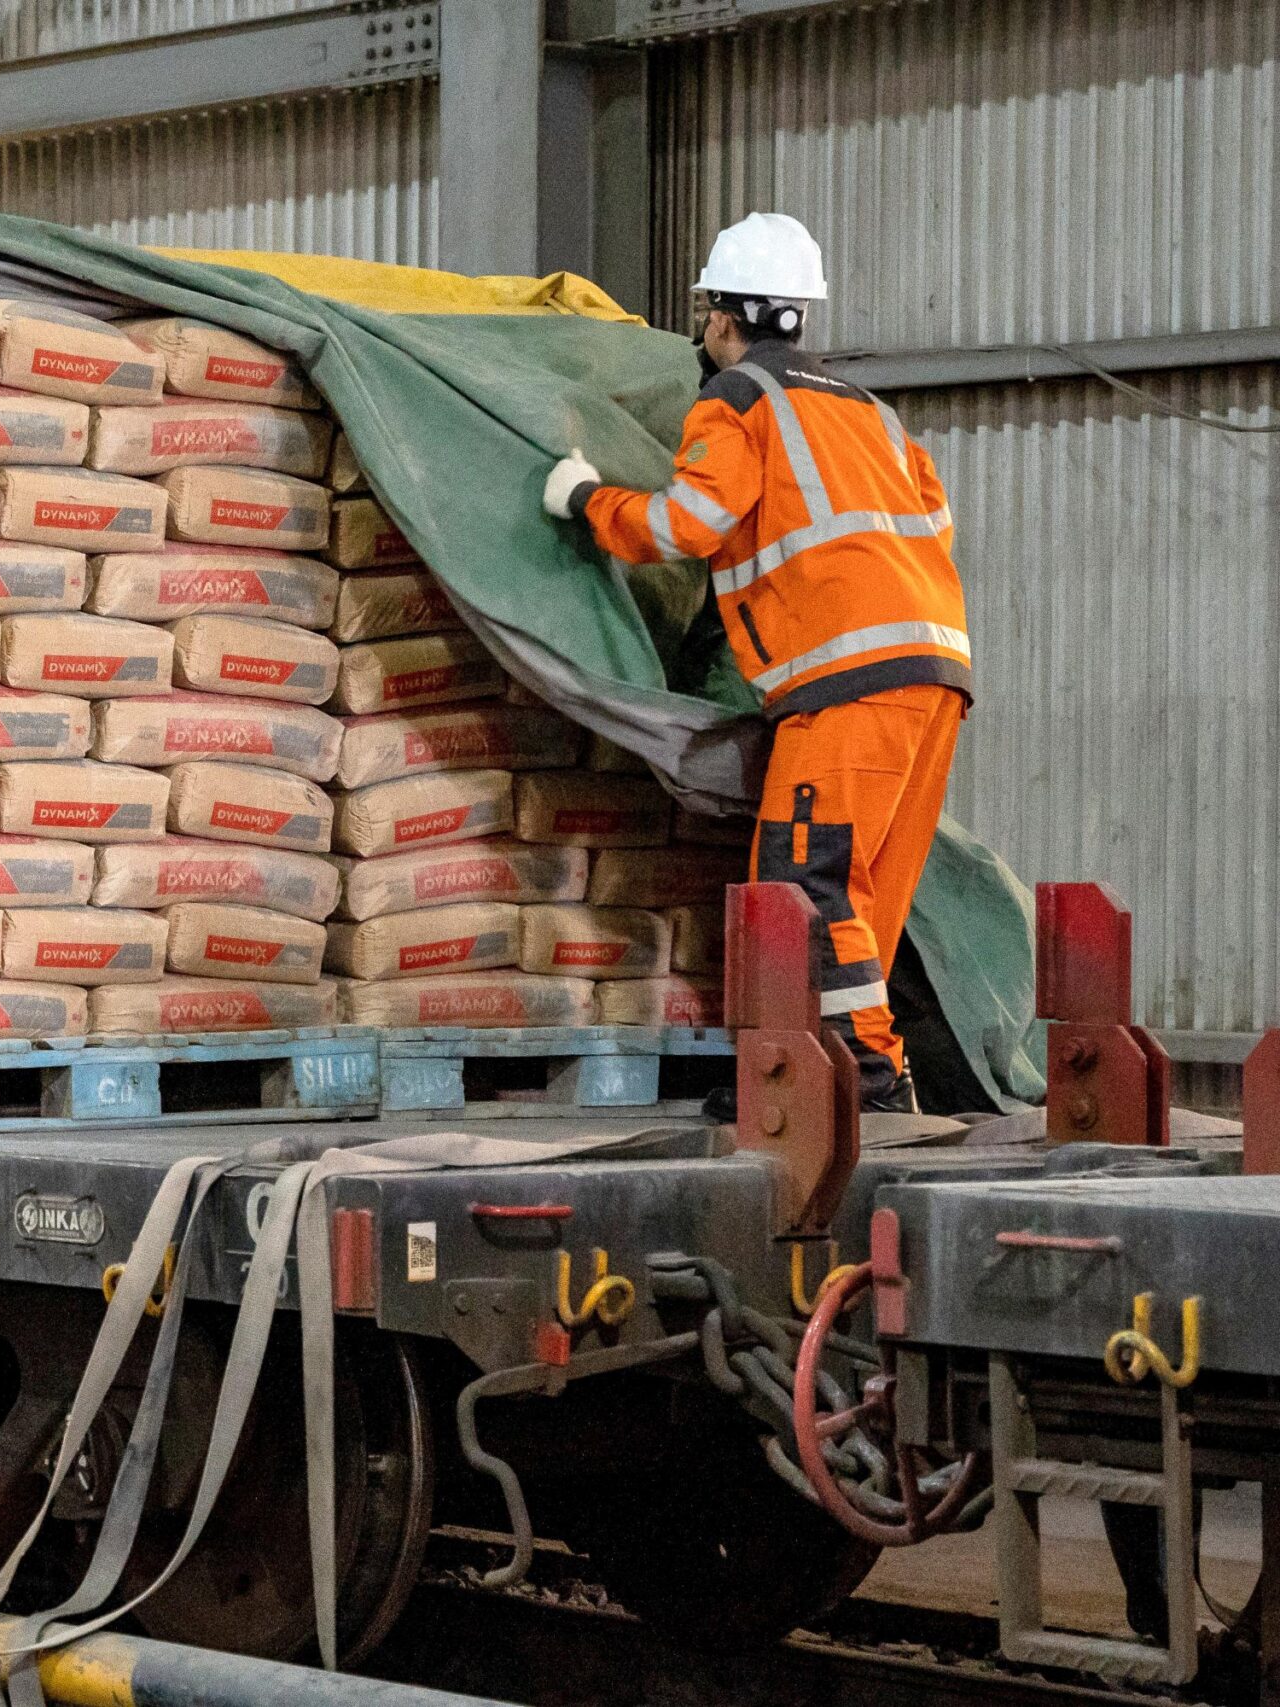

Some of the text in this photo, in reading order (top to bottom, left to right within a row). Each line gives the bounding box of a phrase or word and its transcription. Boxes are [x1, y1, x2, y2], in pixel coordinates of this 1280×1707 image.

[39, 358, 101, 378] DYNAMIX
[212, 363, 270, 381] DYNAMIX
[160, 427, 241, 448] DYNAMIX
[41, 509, 101, 525] DYNAMIX
[216, 505, 273, 524] DYNAMIX
[169, 578, 247, 599] DYNAMIX
[49, 661, 109, 676] DYNAMIX
[226, 661, 281, 679] DYNAMIX
[174, 728, 255, 747] DYNAMIX
[39, 808, 101, 822] DYNAMIX
[217, 809, 273, 828] DYNAMIX
[400, 815, 456, 837] DYNAMIX
[167, 869, 250, 888] DYNAMIX
[423, 867, 500, 891] DYNAMIX
[42, 949, 103, 964] DYNAMIX
[211, 943, 268, 961] DYNAMIX
[405, 944, 462, 964] DYNAMIX
[170, 1000, 250, 1019] DYNAMIX
[428, 996, 504, 1015] DYNAMIX
[38, 1208, 80, 1231] INKA
